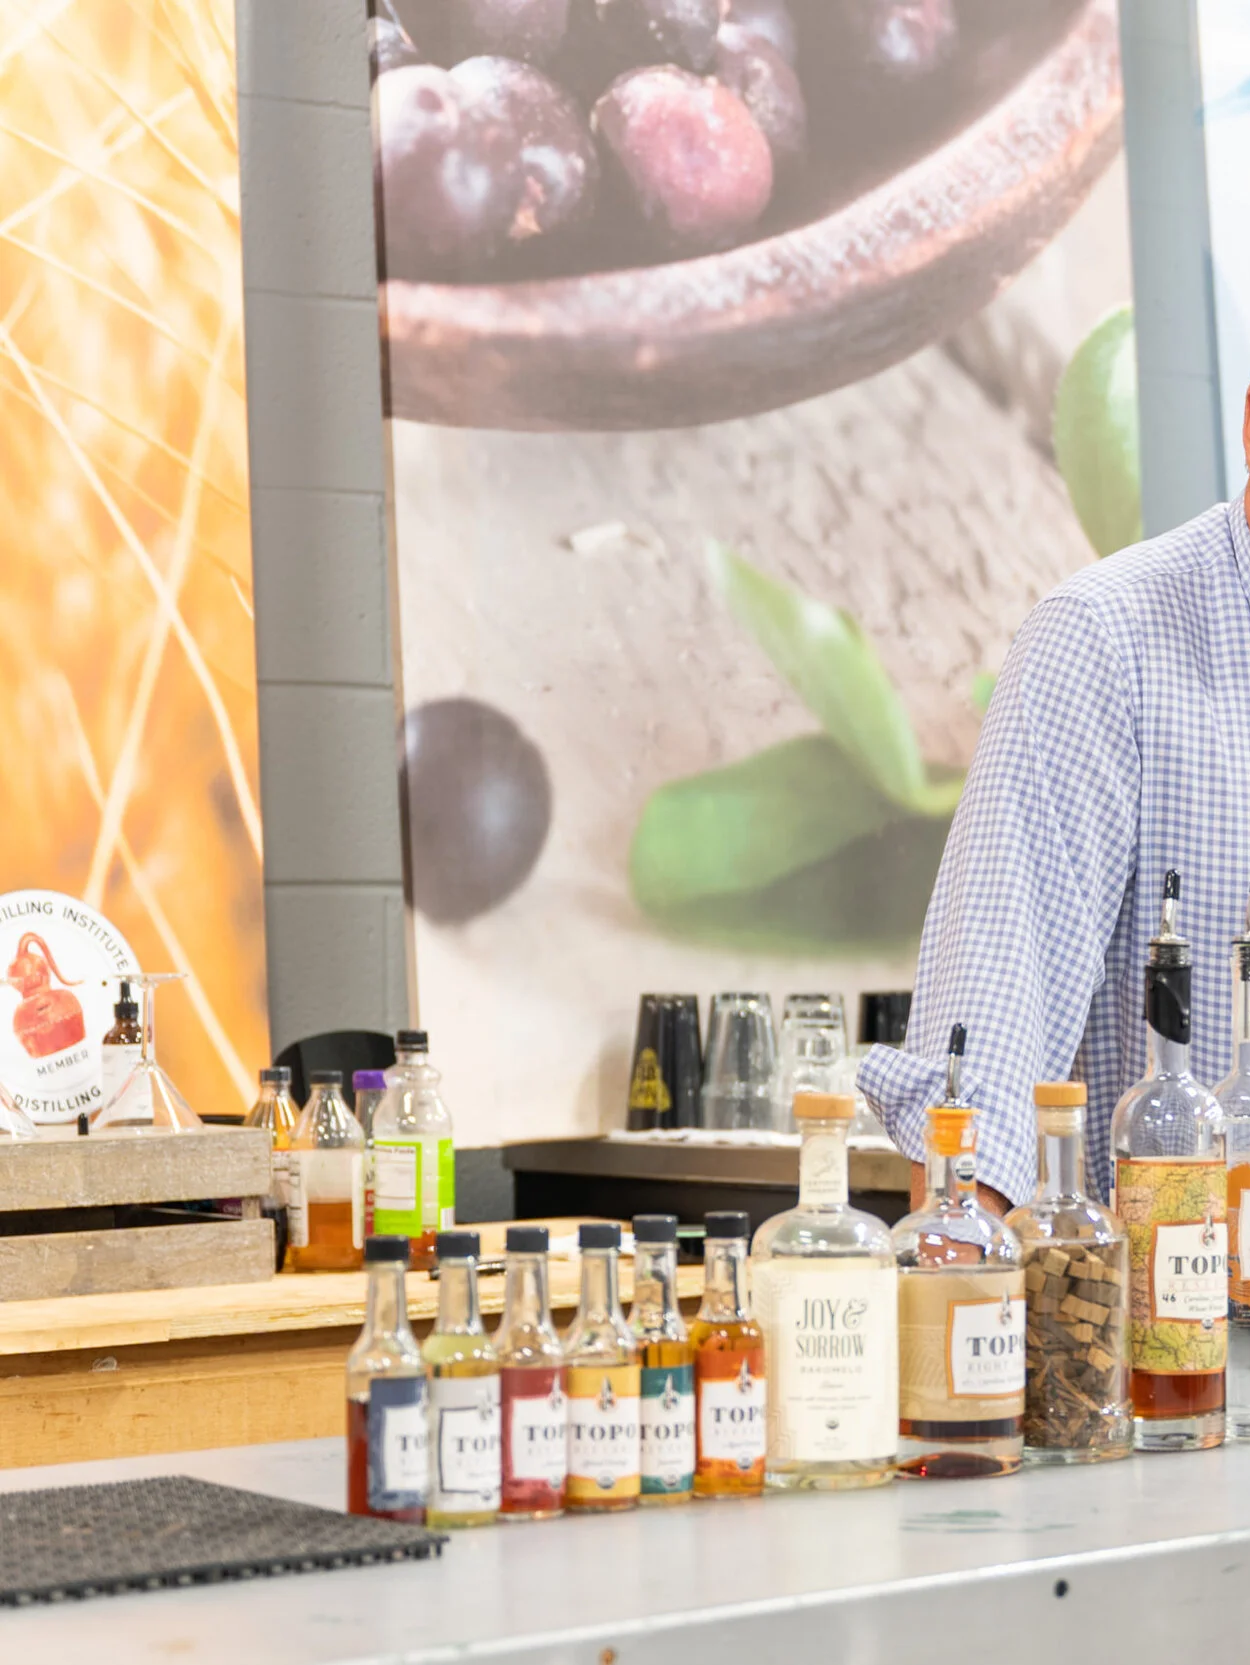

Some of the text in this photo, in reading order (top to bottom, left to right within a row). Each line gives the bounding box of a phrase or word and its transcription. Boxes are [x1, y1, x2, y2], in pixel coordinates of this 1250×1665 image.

[0, 900, 130, 971] ILLING INSTITUTE
[36, 1049, 90, 1077] MEMBER
[14, 1084, 102, 1113] DISTILLING
[795, 1298, 869, 1331] JOY &
[795, 1334, 868, 1359] SORROW
